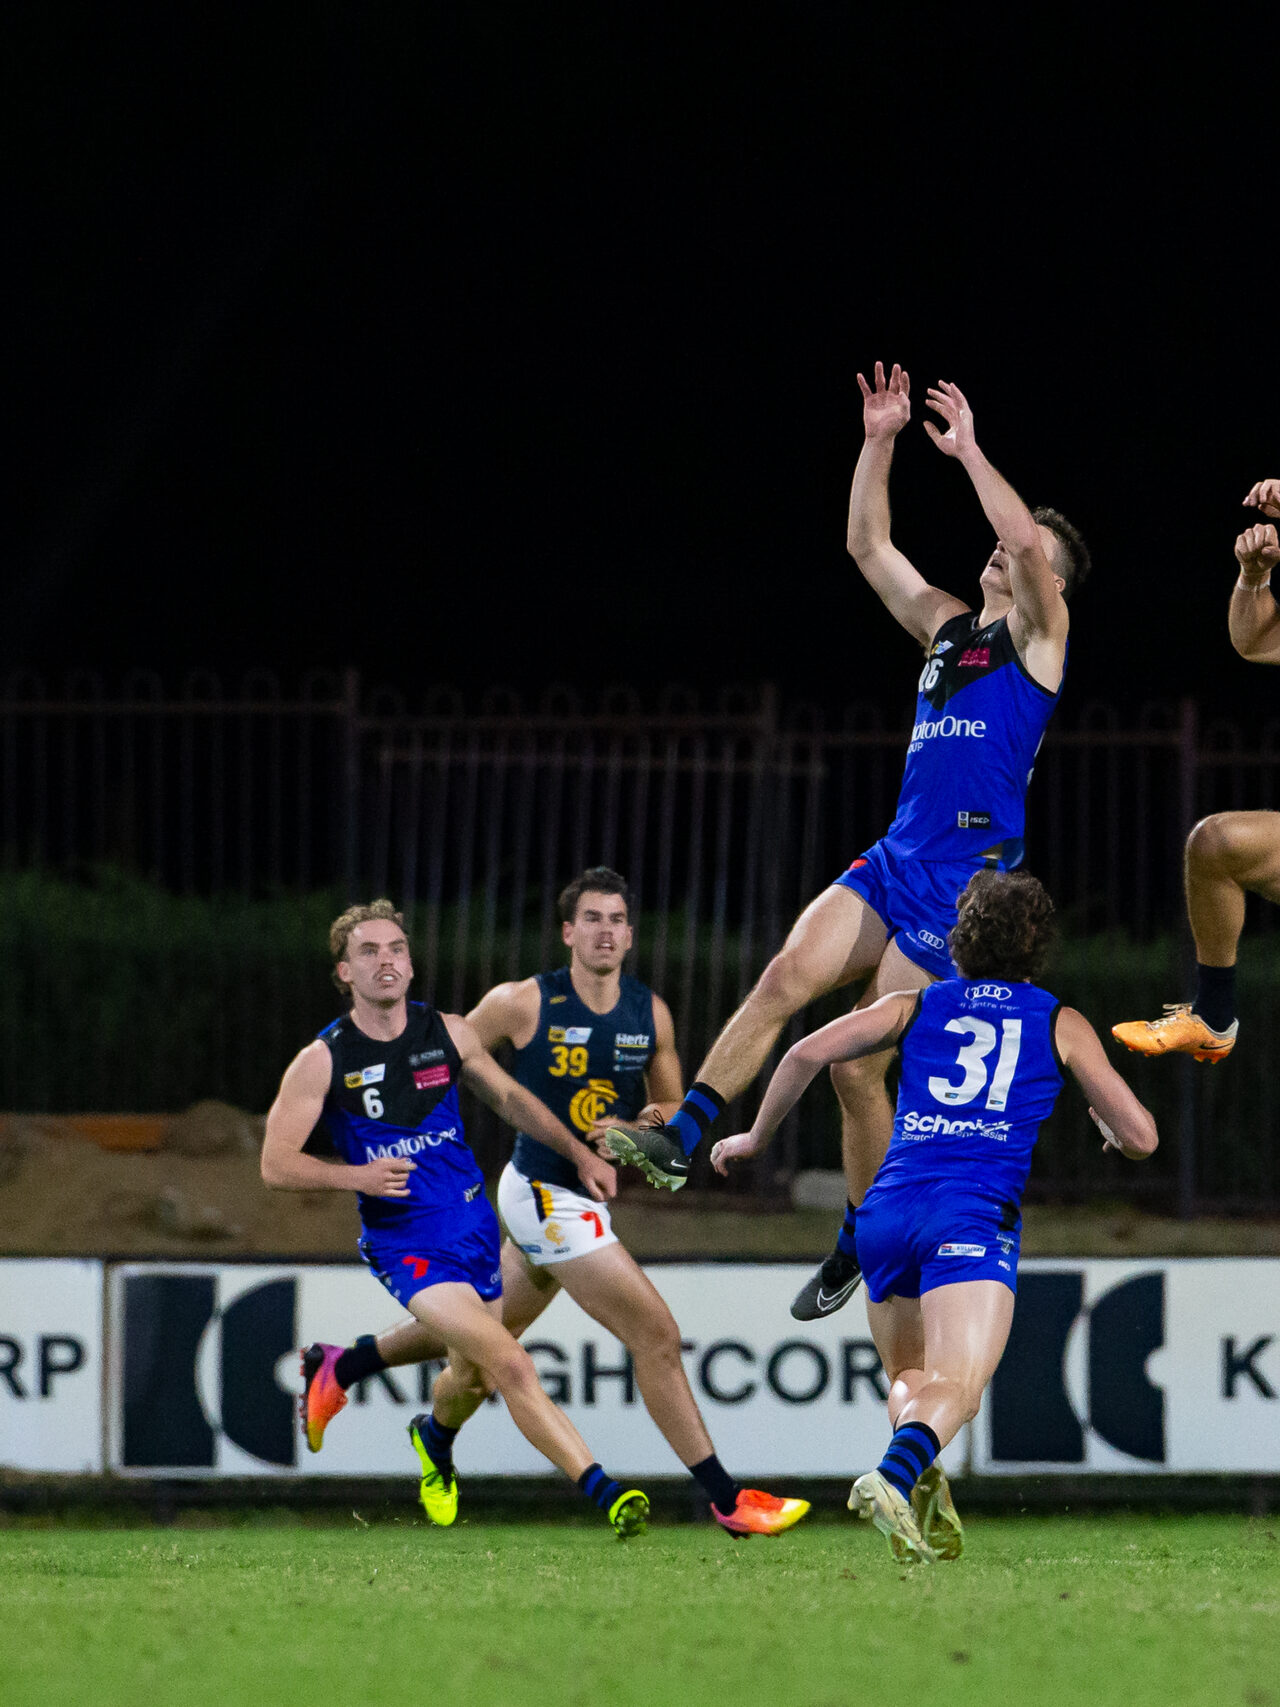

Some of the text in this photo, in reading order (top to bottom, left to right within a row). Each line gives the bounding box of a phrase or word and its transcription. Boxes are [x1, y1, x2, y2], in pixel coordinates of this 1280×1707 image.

[911, 715, 986, 741] otorOne
[615, 1033, 649, 1045] Hertz
[548, 1045, 588, 1077] 39
[928, 1015, 1022, 1112] 31
[362, 1087, 384, 1119] 6
